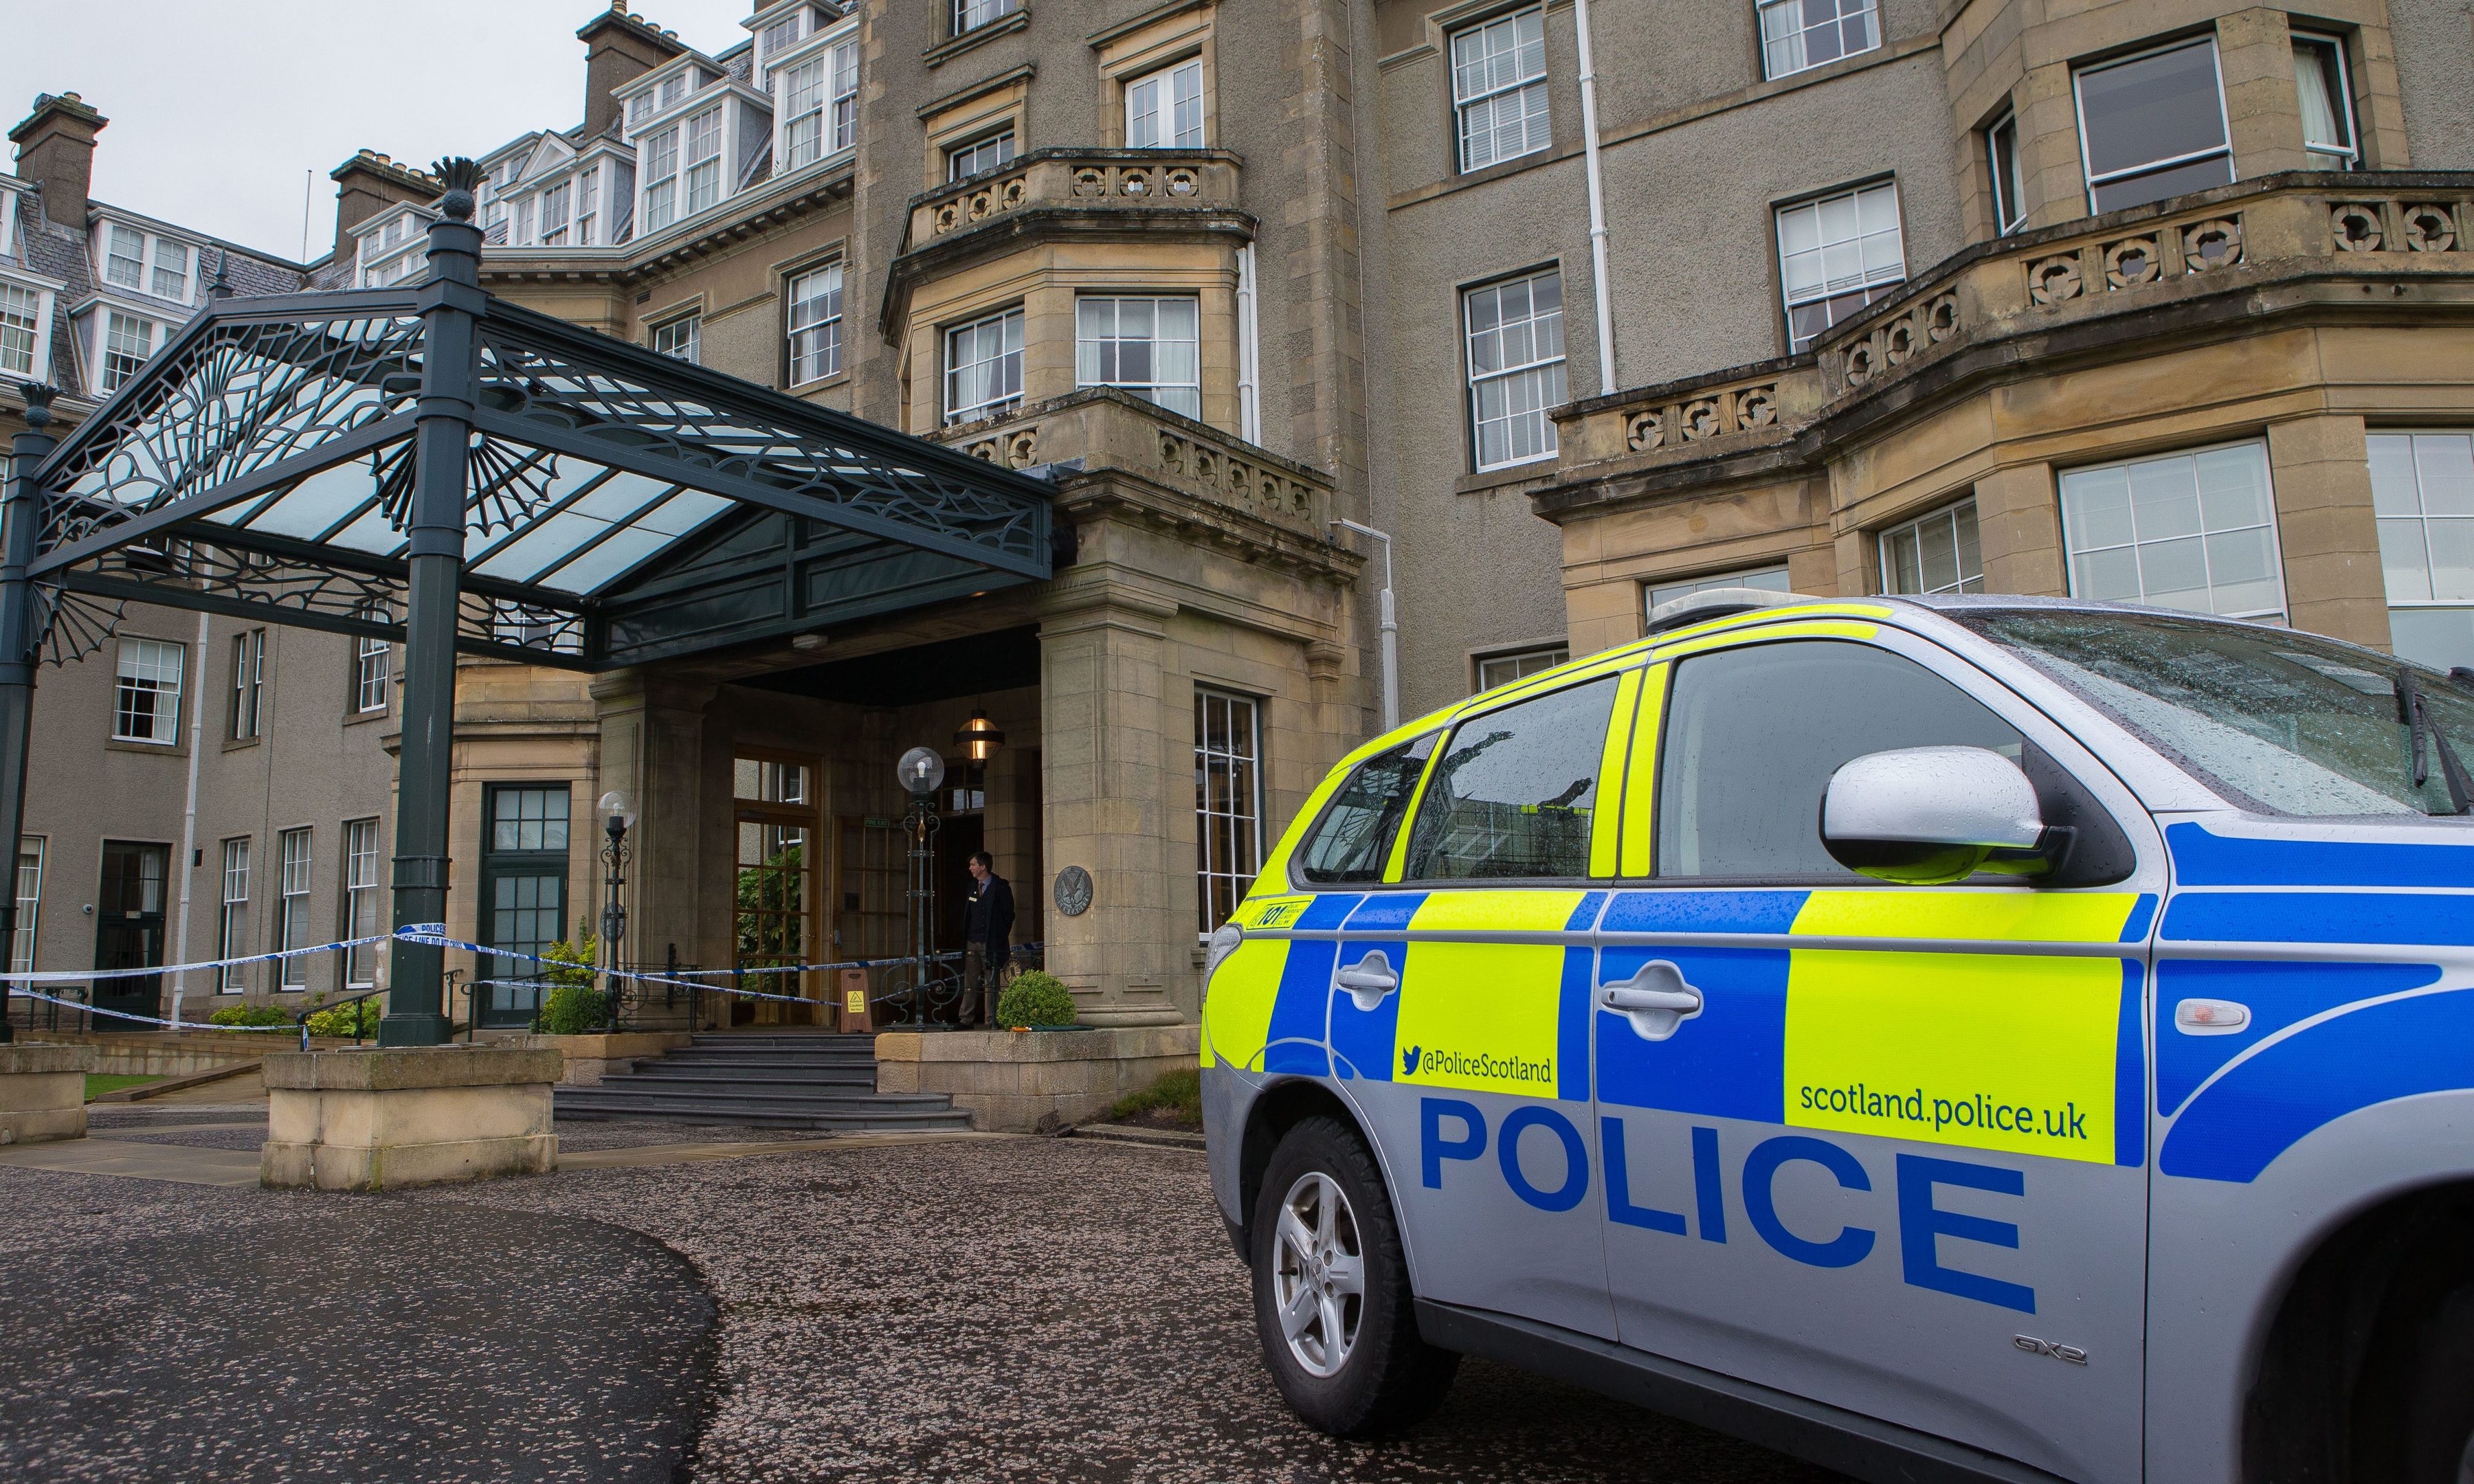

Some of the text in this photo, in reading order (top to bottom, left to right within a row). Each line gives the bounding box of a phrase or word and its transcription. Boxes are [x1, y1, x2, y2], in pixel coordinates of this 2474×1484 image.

[421, 923, 443, 934] POLICE
[1257, 906, 1289, 925] 101
[1423, 1048, 1551, 1084] @PoliceScotland
[1801, 1083, 2087, 1140] scotland.police.uk
[1420, 1097, 2036, 1315] POLICE
[2012, 1334, 2087, 1365] GX2
